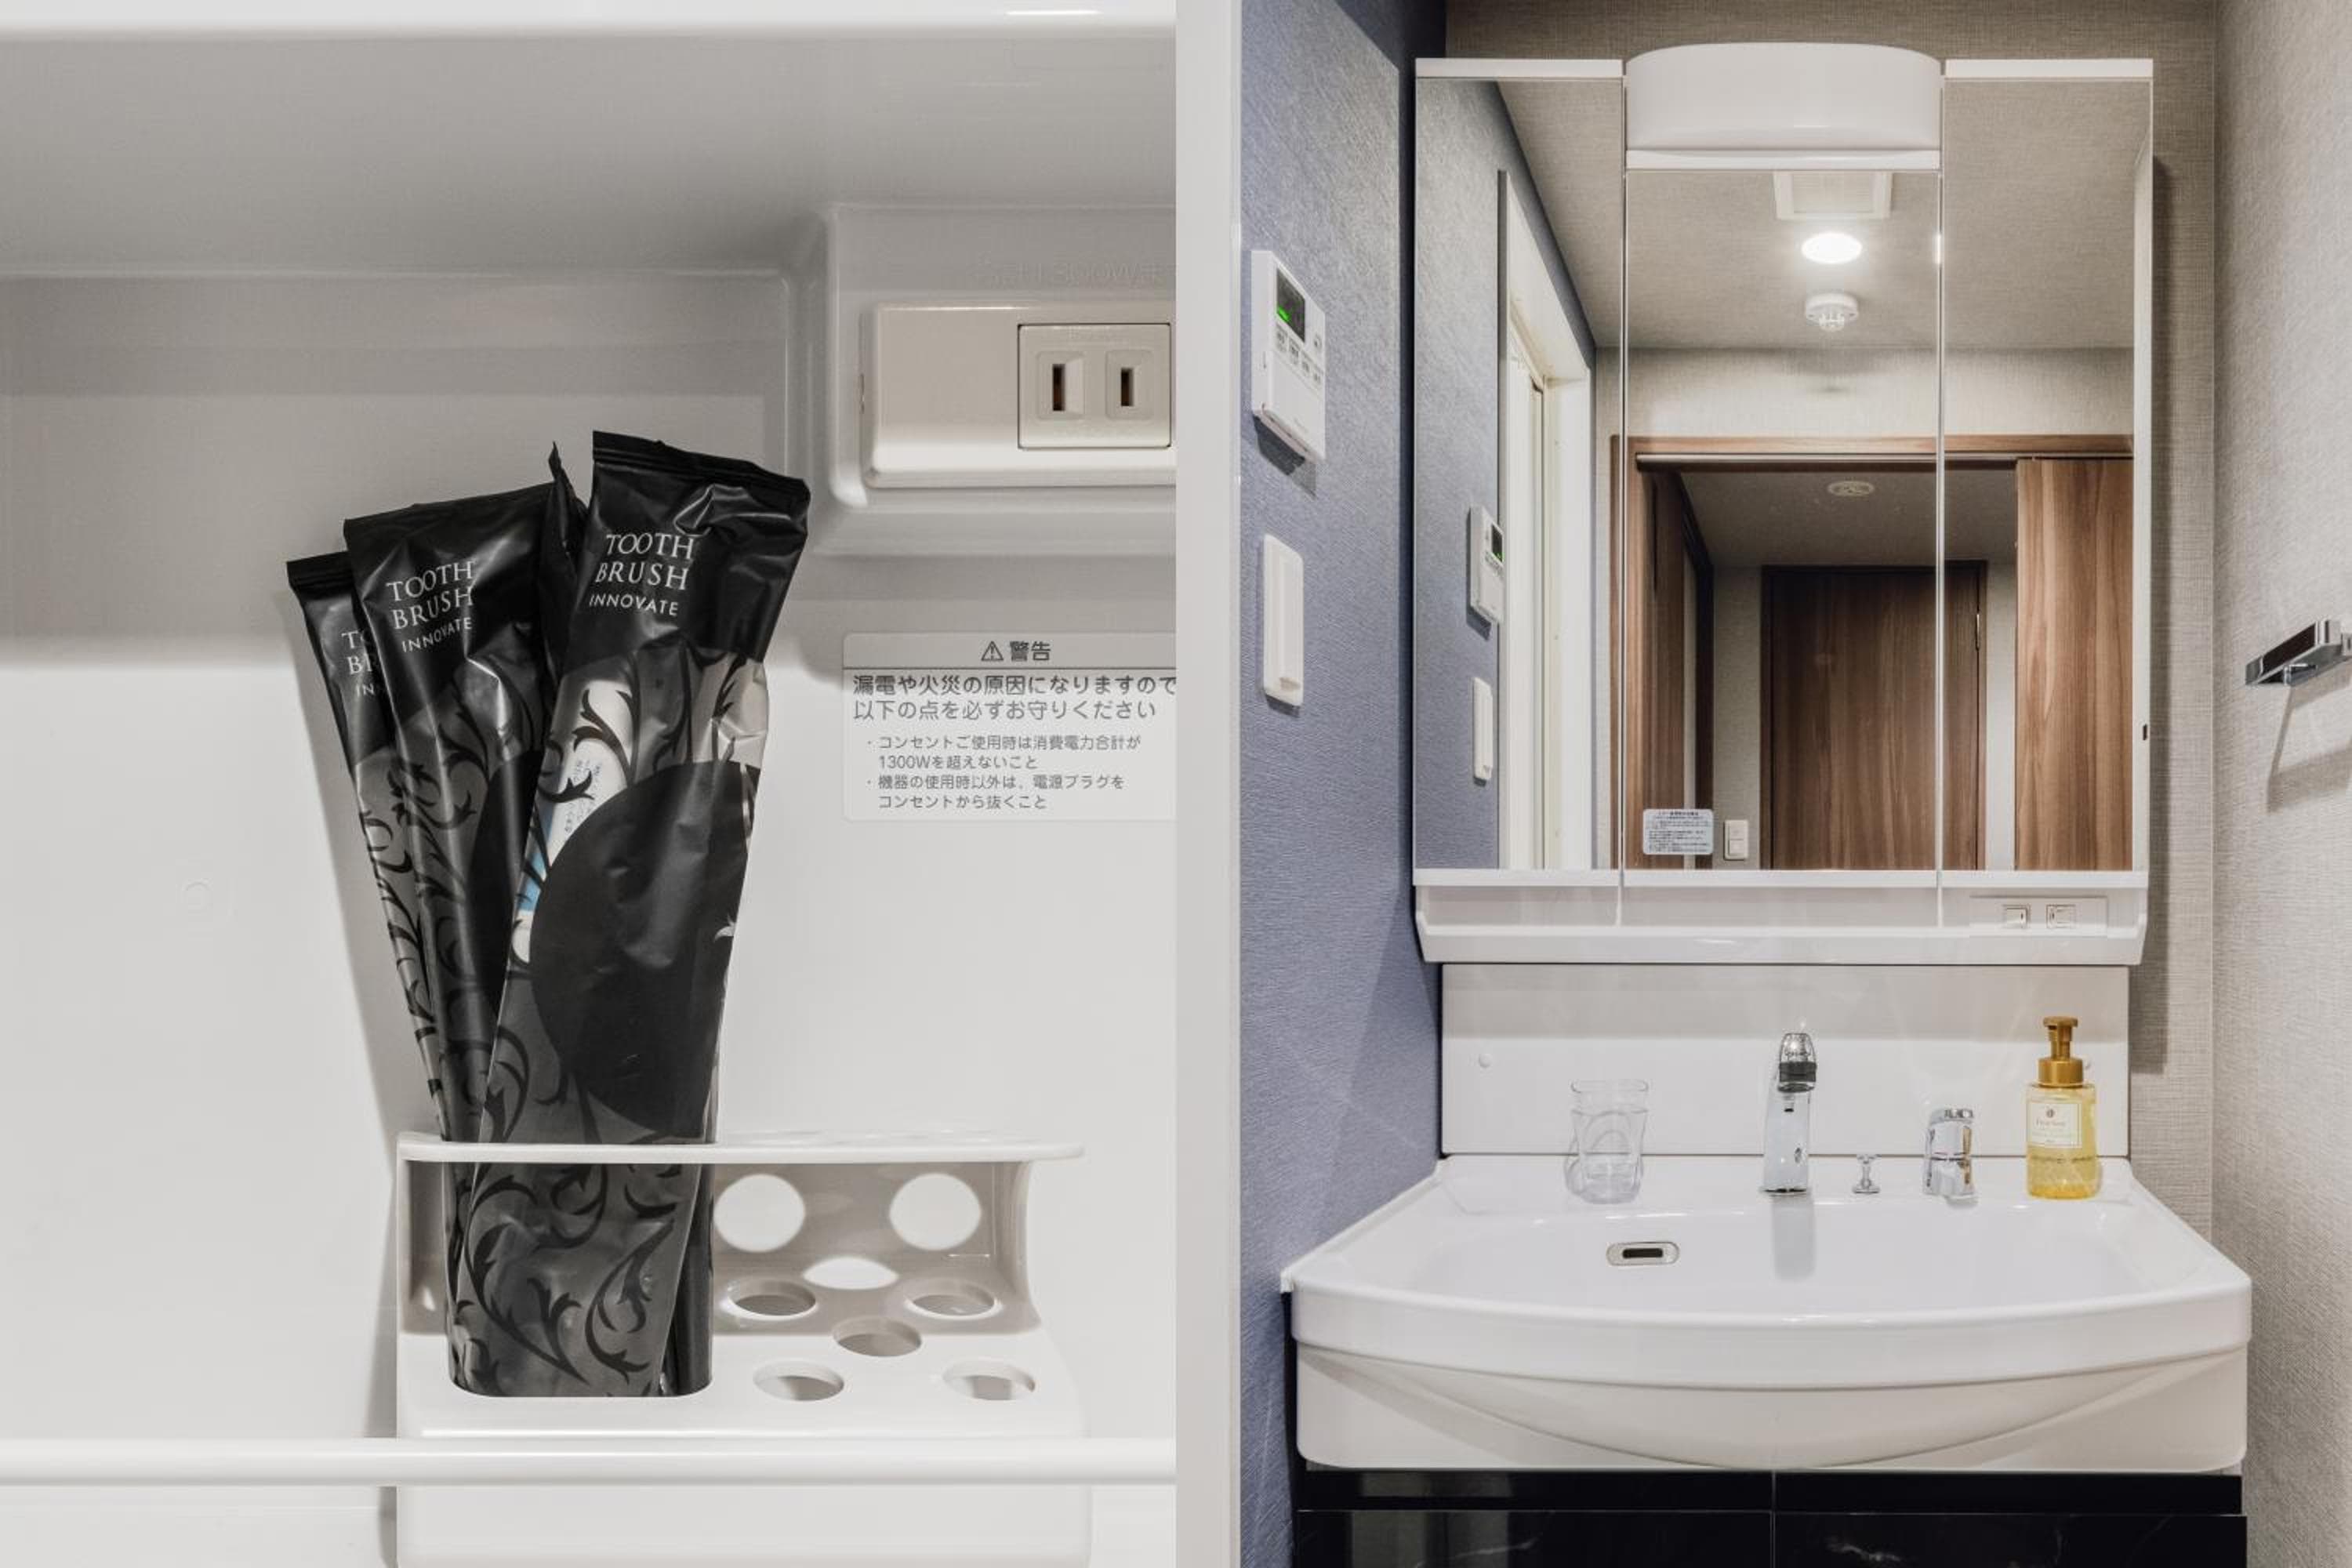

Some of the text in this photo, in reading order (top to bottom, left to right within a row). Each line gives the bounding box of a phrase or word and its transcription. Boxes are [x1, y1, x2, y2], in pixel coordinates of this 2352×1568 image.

[605, 533, 694, 560] TOOTH
[386, 561, 475, 601] TOOTH
[595, 561, 689, 590] BRUSH
[392, 586, 474, 630] BRUSH
[589, 593, 678, 617] INNOVATE
[401, 617, 472, 653] INNOVATE
[1009, 640, 1051, 662] 警告
[853, 675, 1176, 695] 漏電や火災の原因になりますので
[853, 699, 1156, 720] 以下の点を必ずお守りください
[878, 754, 1039, 770] 1300Wを超えないこと
[878, 795, 1047, 810] コンセントから抜くこと
